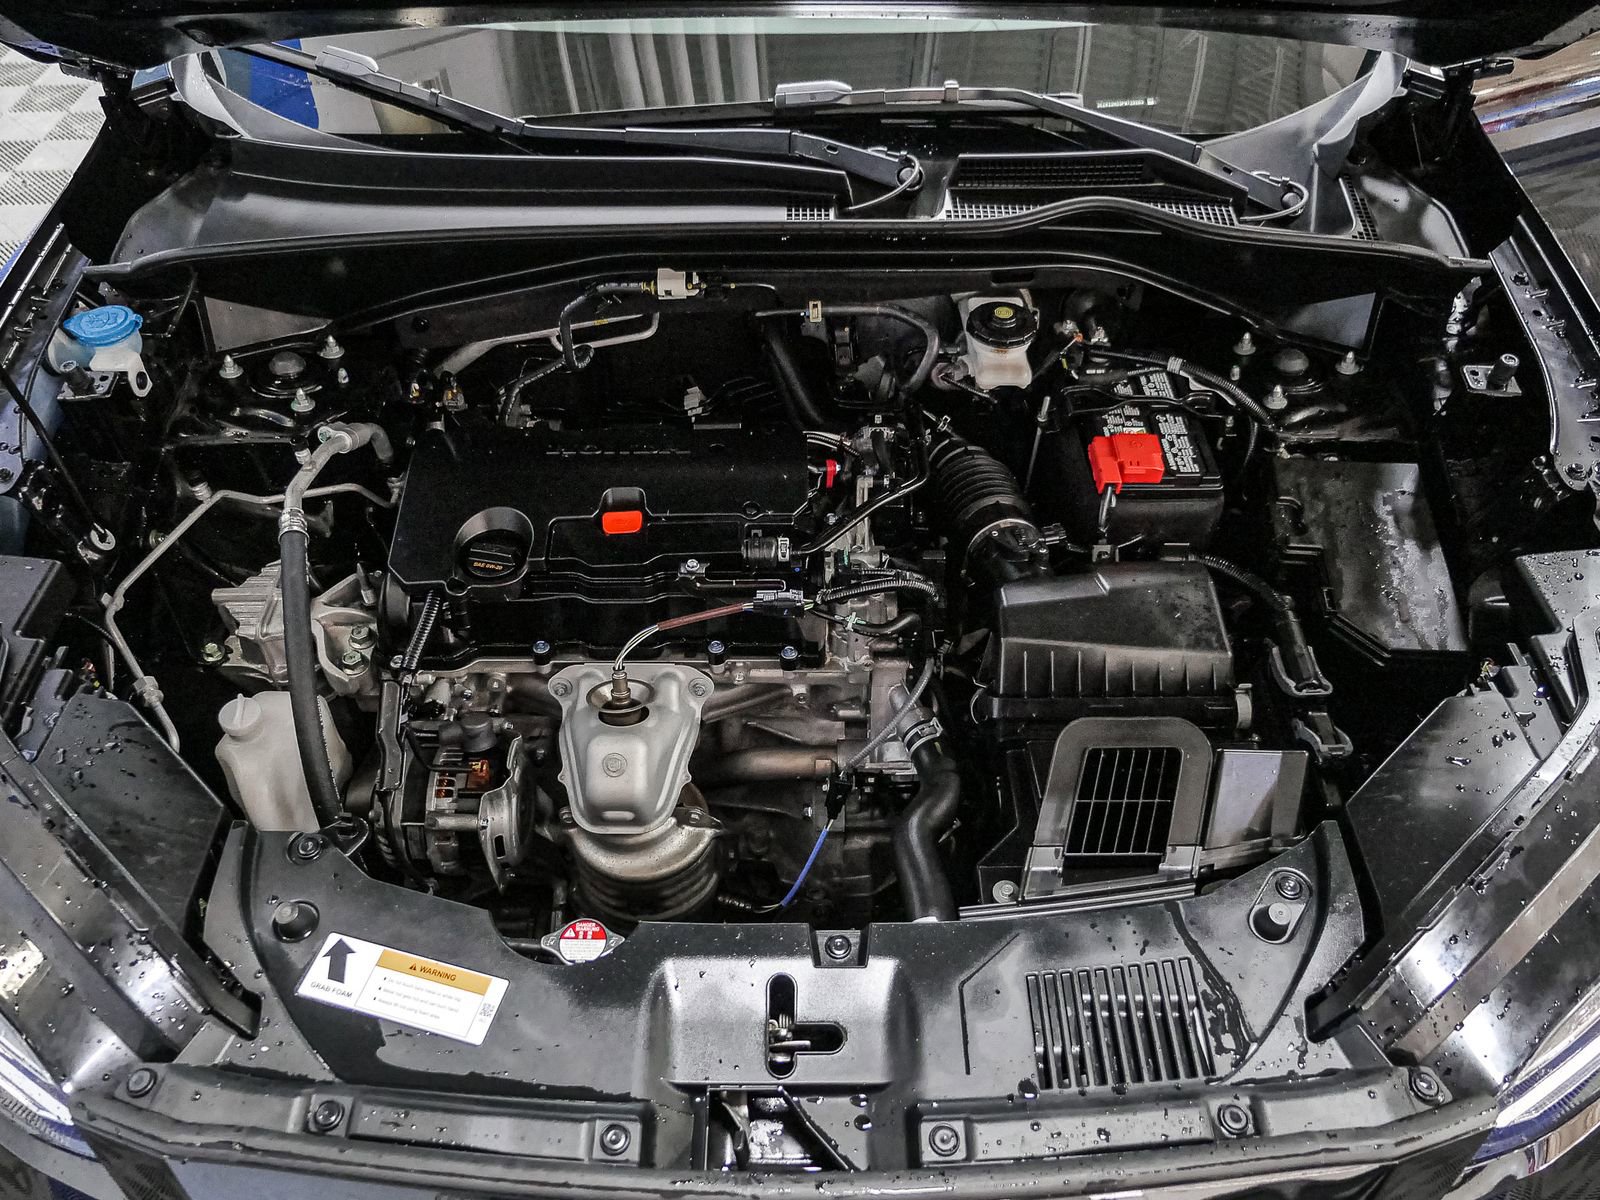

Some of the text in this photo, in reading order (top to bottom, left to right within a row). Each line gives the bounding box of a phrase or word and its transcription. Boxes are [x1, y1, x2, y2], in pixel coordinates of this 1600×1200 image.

[420, 965, 457, 982] WARNING
[310, 981, 353, 998] GRAB FOAM
